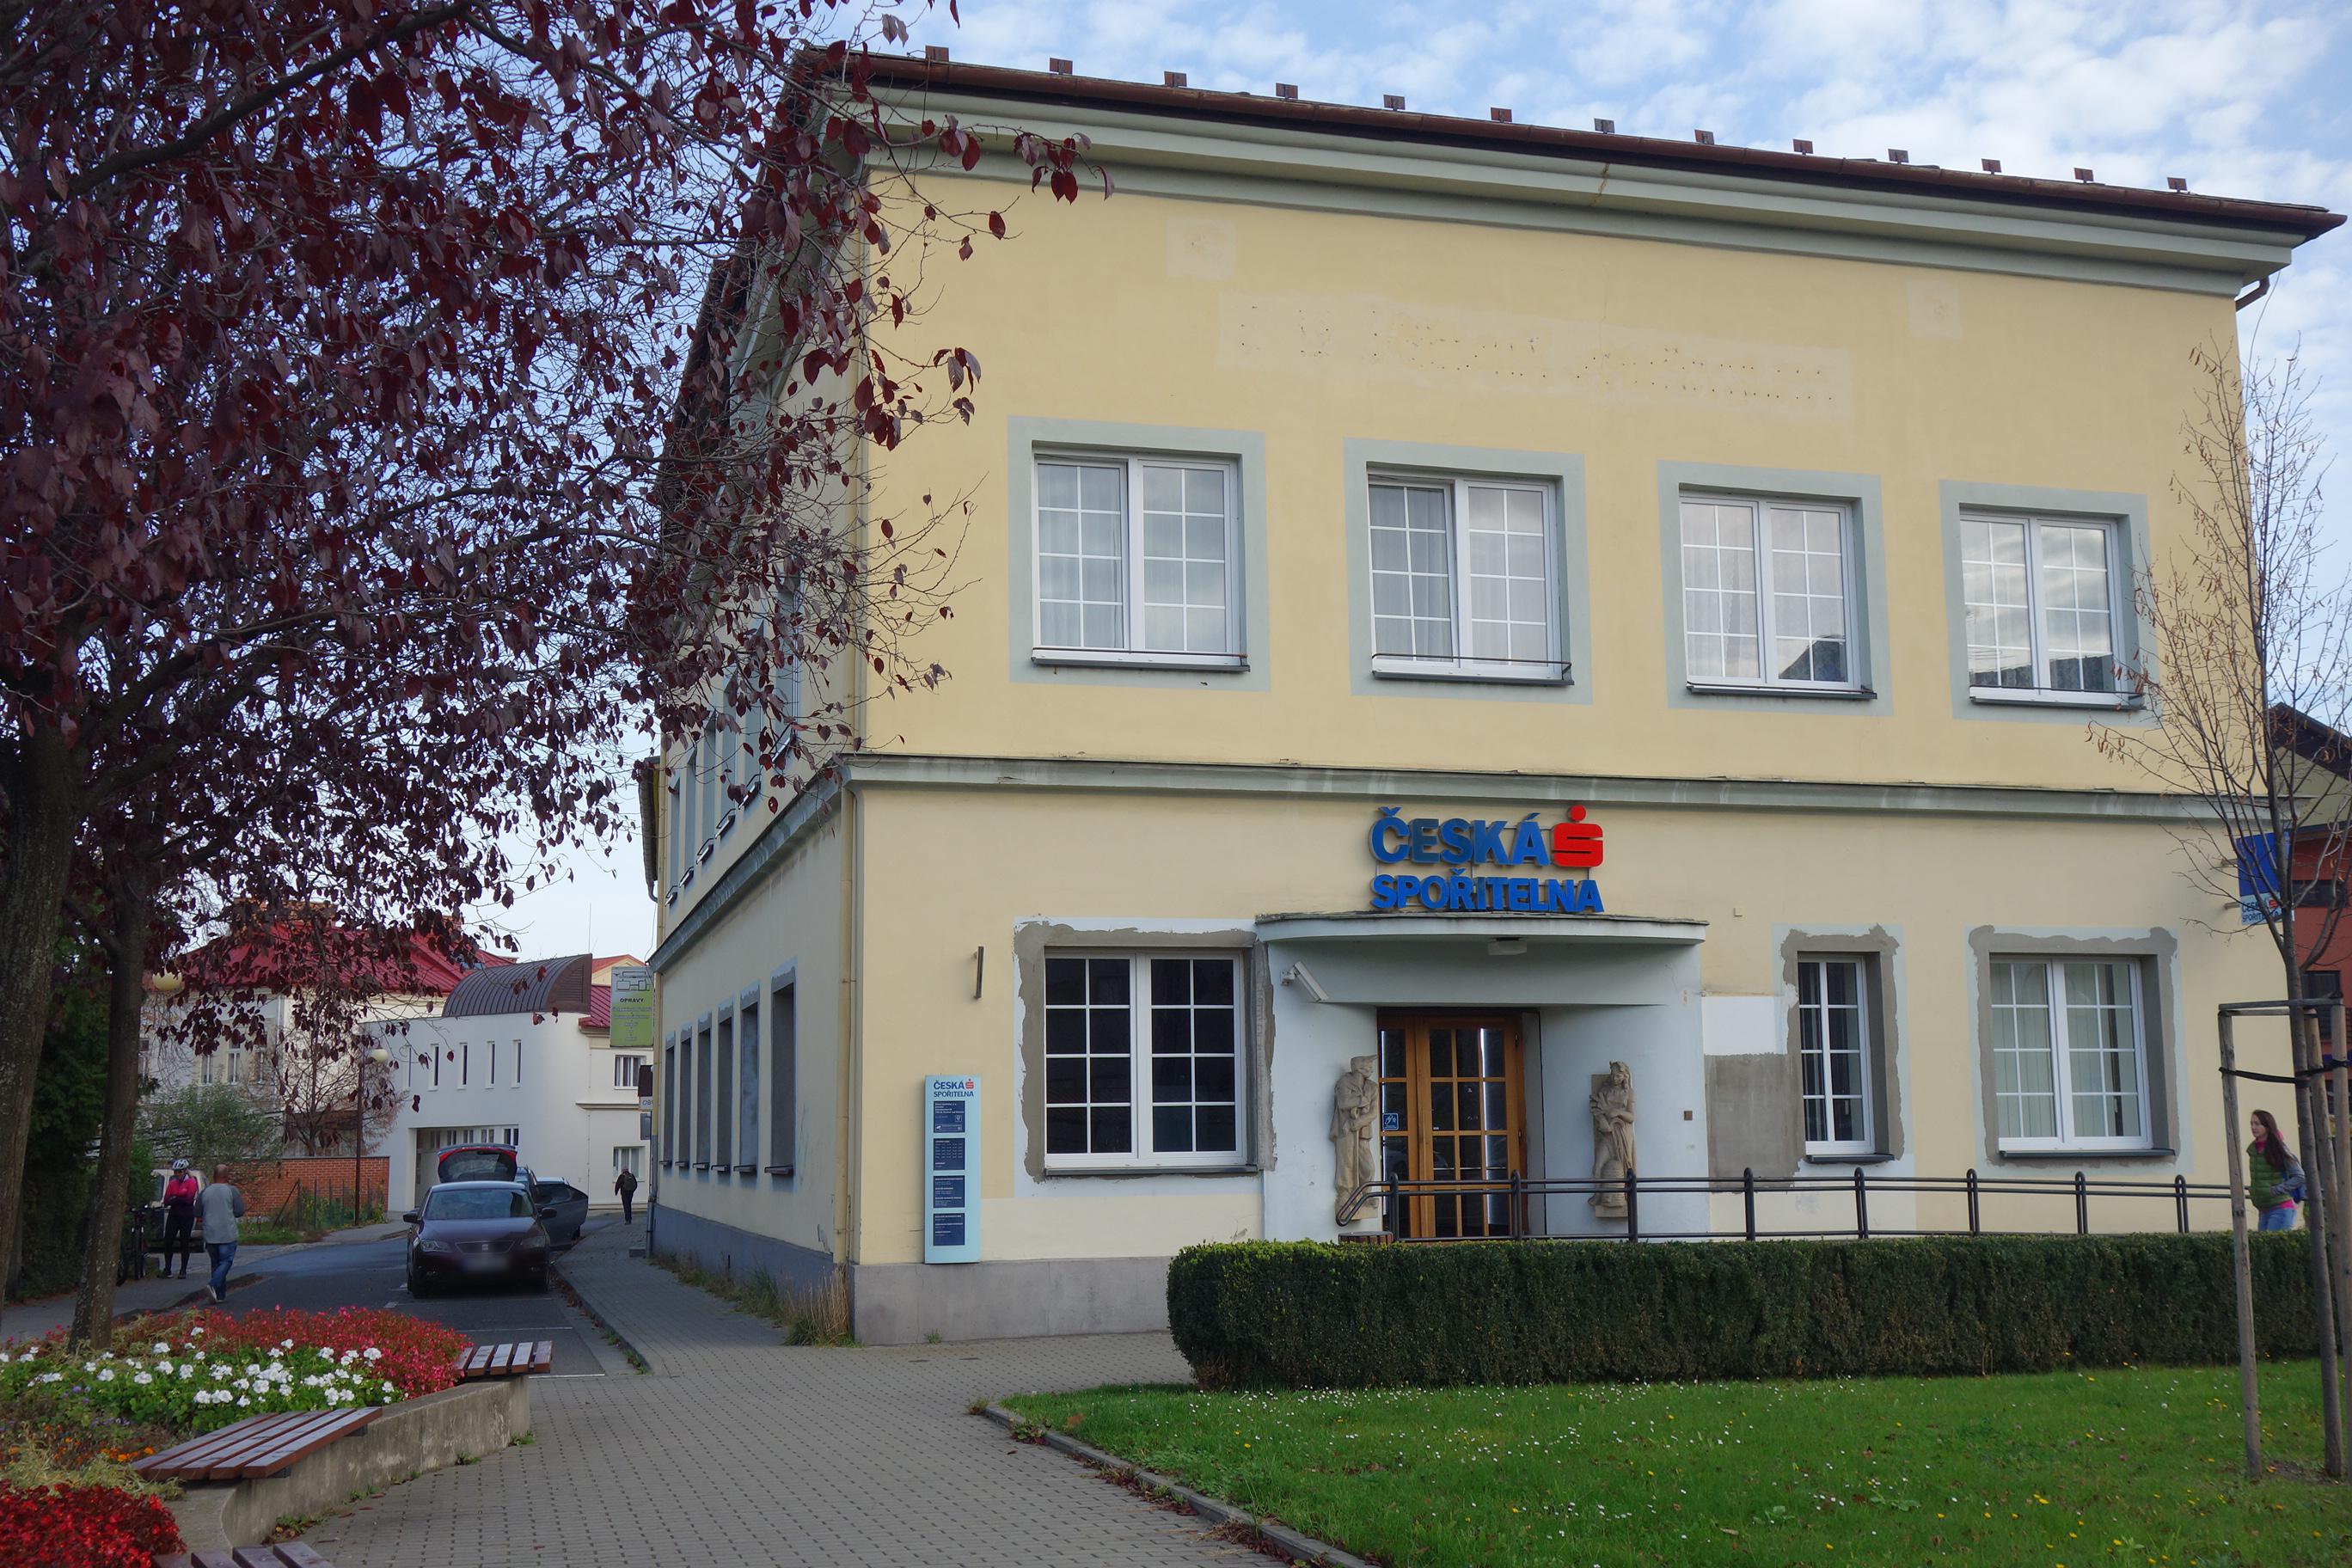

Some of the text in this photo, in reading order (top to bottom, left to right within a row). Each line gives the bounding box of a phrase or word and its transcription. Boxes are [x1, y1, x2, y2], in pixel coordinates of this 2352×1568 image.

[1370, 806, 1551, 867] ČESKÁ
[1371, 867, 1605, 913] SPOŘITELNA
[934, 1080, 965, 1089] ČESKÁ
